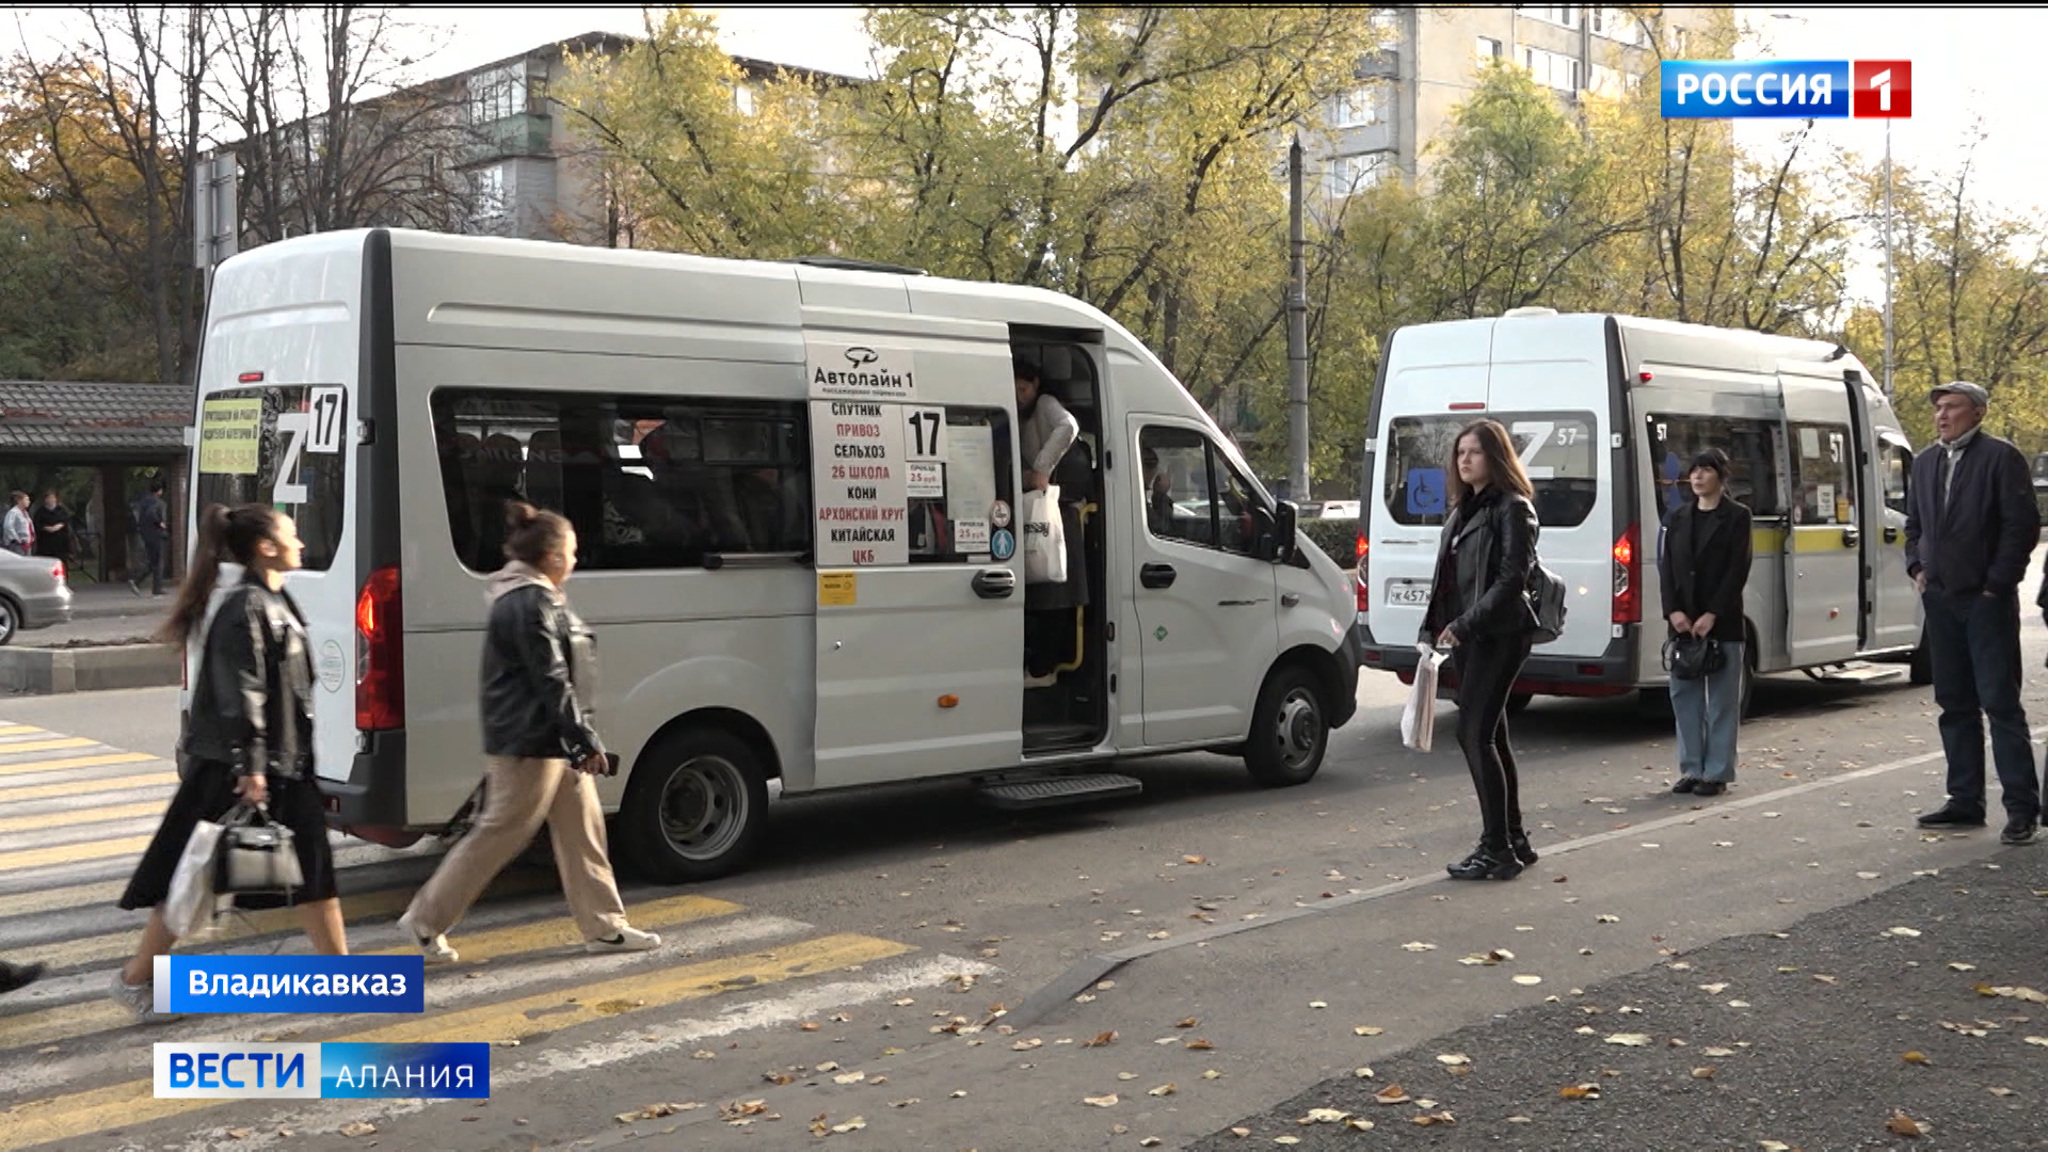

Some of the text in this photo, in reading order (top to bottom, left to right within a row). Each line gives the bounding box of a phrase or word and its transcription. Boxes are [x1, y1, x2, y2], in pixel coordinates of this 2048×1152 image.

[814, 366, 914, 388] Автолайн 1
[831, 402, 882, 417] СПУТНИК
[314, 394, 338, 446] 17
[836, 423, 881, 437] ПРИВОЗ
[908, 411, 940, 456] 17
[1557, 428, 1577, 446] 57
[1656, 422, 1668, 441] 57
[834, 443, 885, 459] СЕЛЬХОЗ
[1829, 433, 1843, 463] 57
[273, 412, 310, 503] Z
[831, 466, 890, 480] 26 ШКОЛА
[910, 473, 922, 482] 25
[847, 485, 877, 500] КОНИ
[819, 505, 905, 521] АРХОНСКИЙ КРУГ
[831, 527, 895, 542] КИТАЙСКАЯ
[959, 528, 971, 538] 25
[852, 549, 875, 564] ЦКБ
